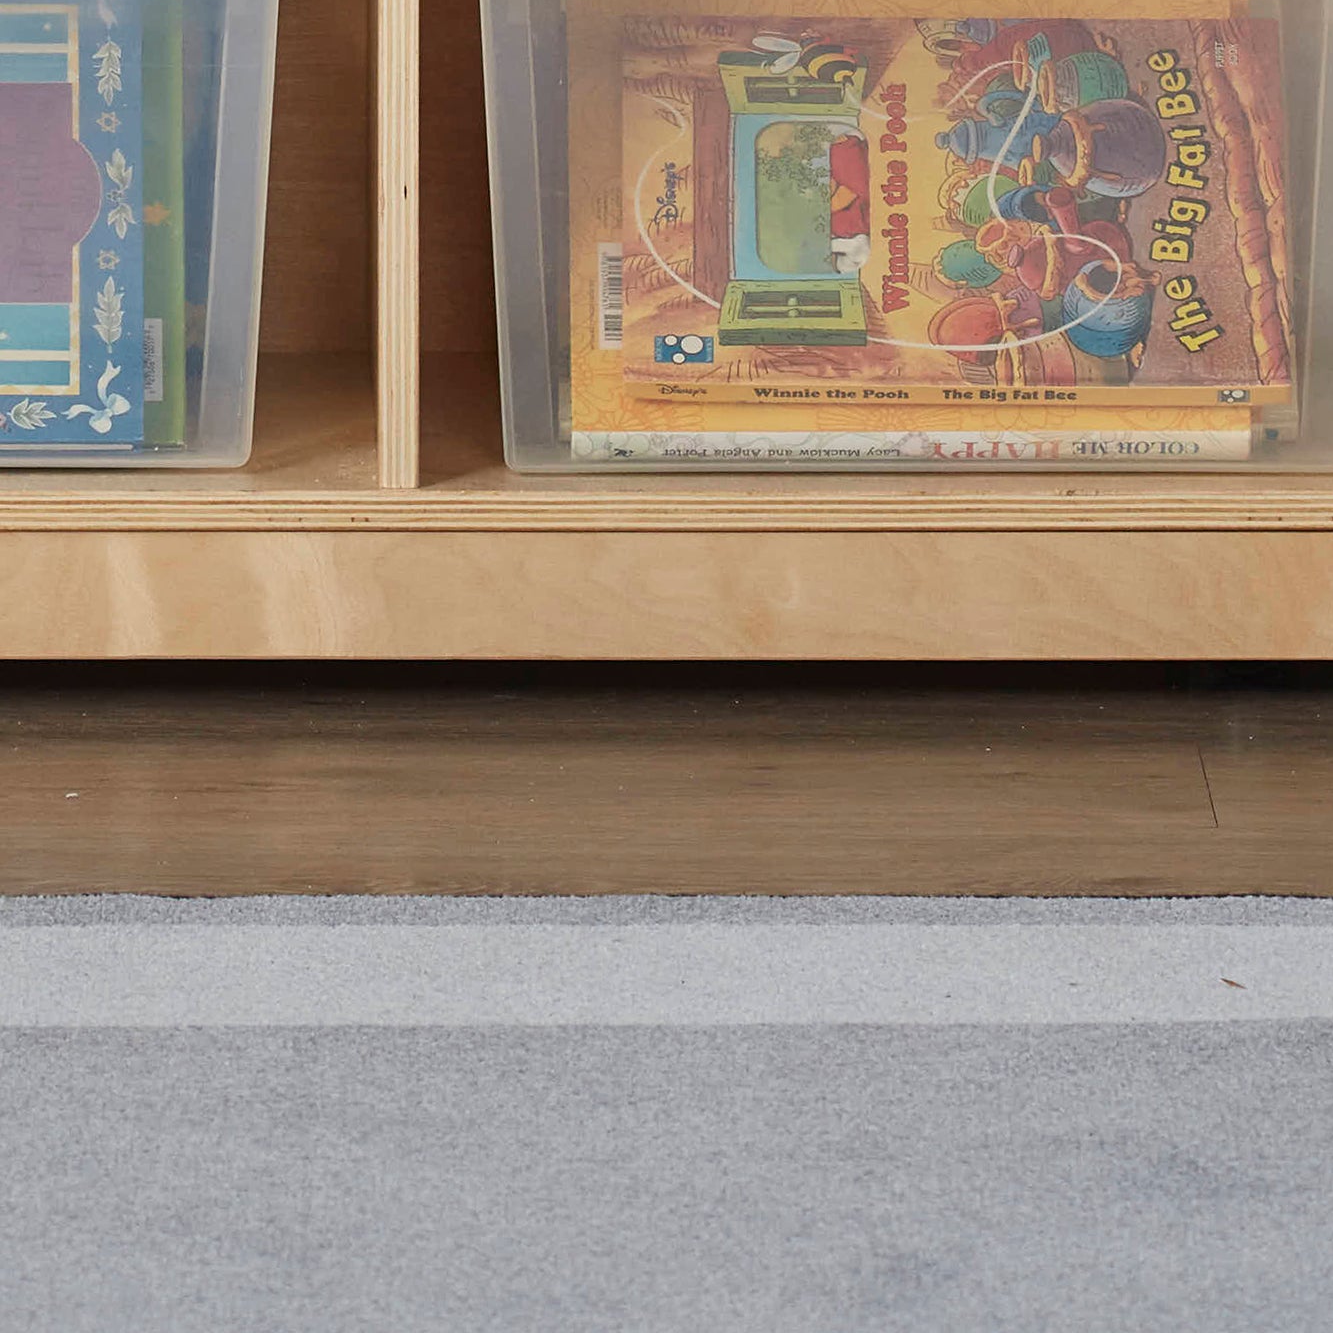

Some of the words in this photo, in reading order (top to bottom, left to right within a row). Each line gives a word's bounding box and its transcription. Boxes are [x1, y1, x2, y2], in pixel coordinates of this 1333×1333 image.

[1147, 49, 1201, 120] Bee
[879, 83, 908, 153] Pooh
[1166, 124, 1211, 190] Fat
[880, 160, 908, 207] the
[1149, 197, 1211, 264] Big
[881, 213, 910, 314] Winnie
[1164, 275, 1226, 353] The
[753, 387, 821, 399] Winnie
[826, 388, 857, 399] the
[862, 388, 910, 400] Pooh
[942, 389, 974, 401] The
[979, 389, 1007, 402] Big
[1012, 389, 1040, 401] Fat
[1044, 389, 1078, 401] Bee
[713, 446, 761, 459] Angela
[767, 447, 794, 458] and
[799, 447, 861, 458] Mucklow
[867, 446, 901, 458] Lacy
[929, 438, 1064, 460] HAPPY
[1071, 441, 1109, 456] ME
[1117, 440, 1200, 456] COLOR
